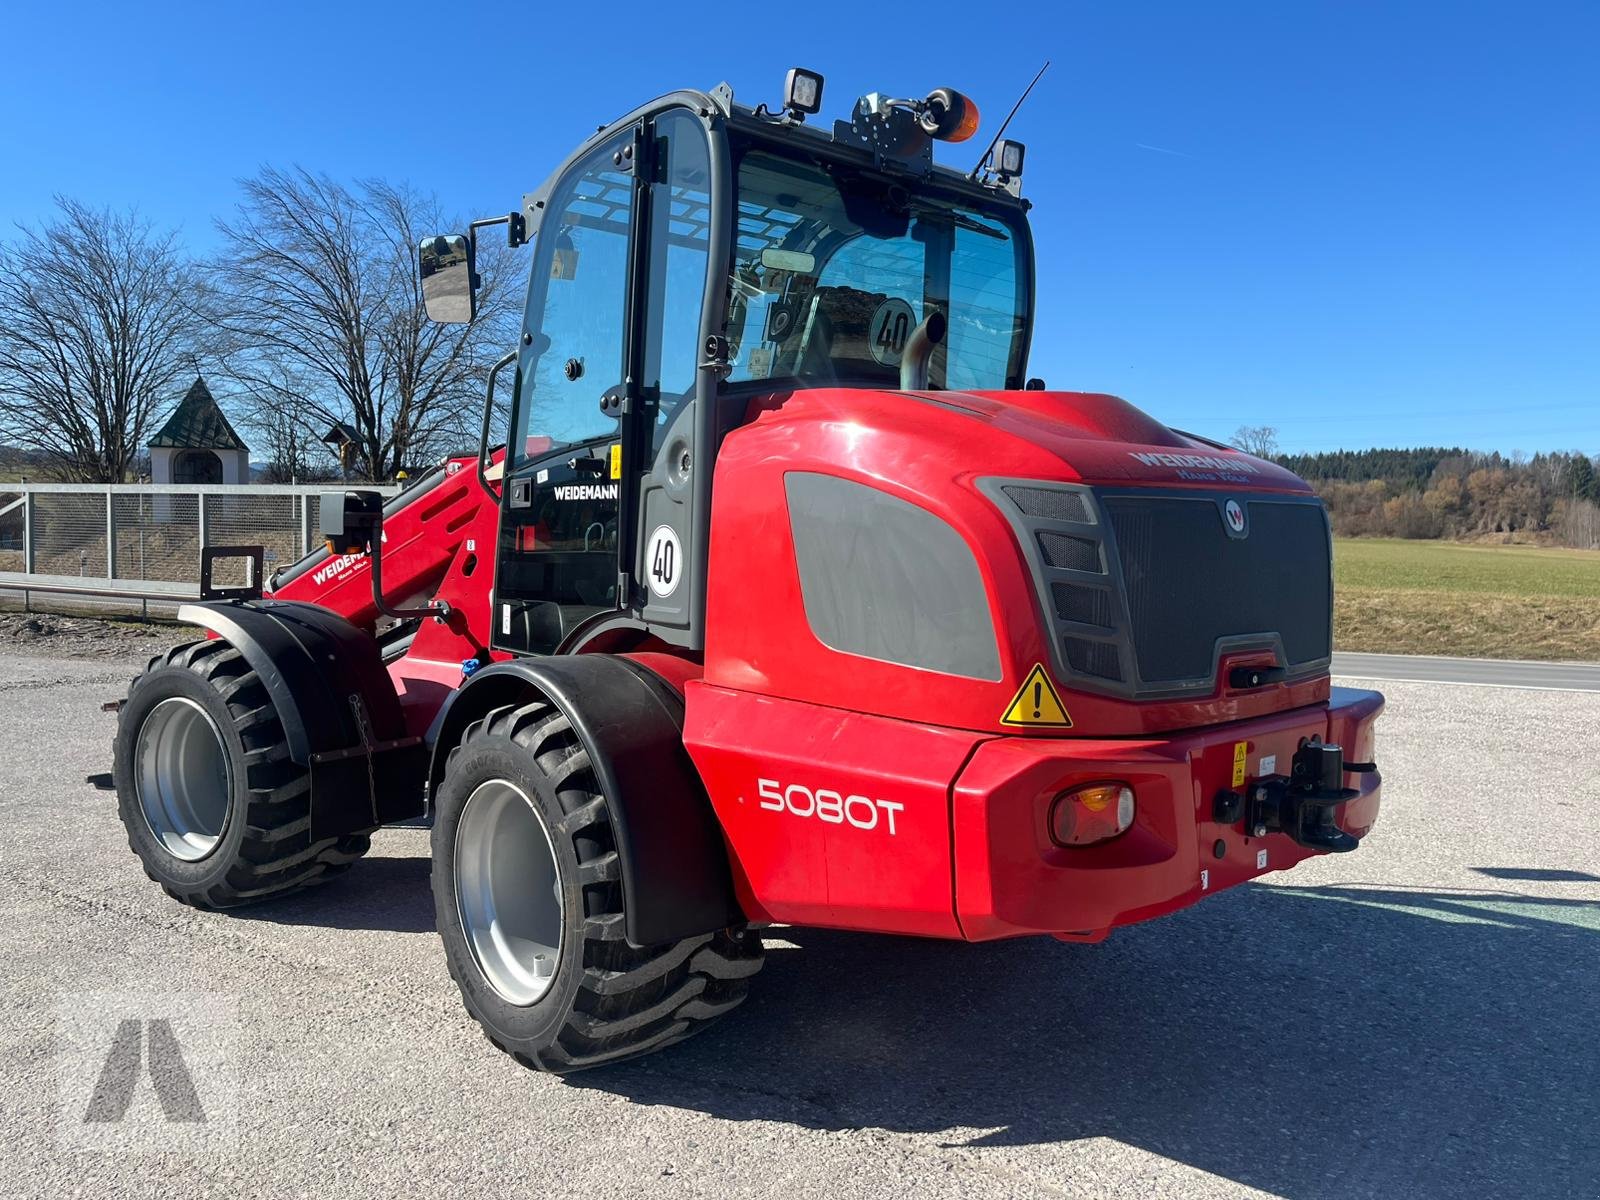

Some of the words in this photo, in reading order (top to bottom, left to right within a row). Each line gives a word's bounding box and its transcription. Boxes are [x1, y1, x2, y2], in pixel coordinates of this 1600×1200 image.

[877, 309, 909, 352] 40
[1128, 452, 1261, 474] WEIDEMANN
[554, 484, 619, 501] WEIDEMANN
[652, 538, 674, 585] 40
[757, 777, 905, 836] 5080T
